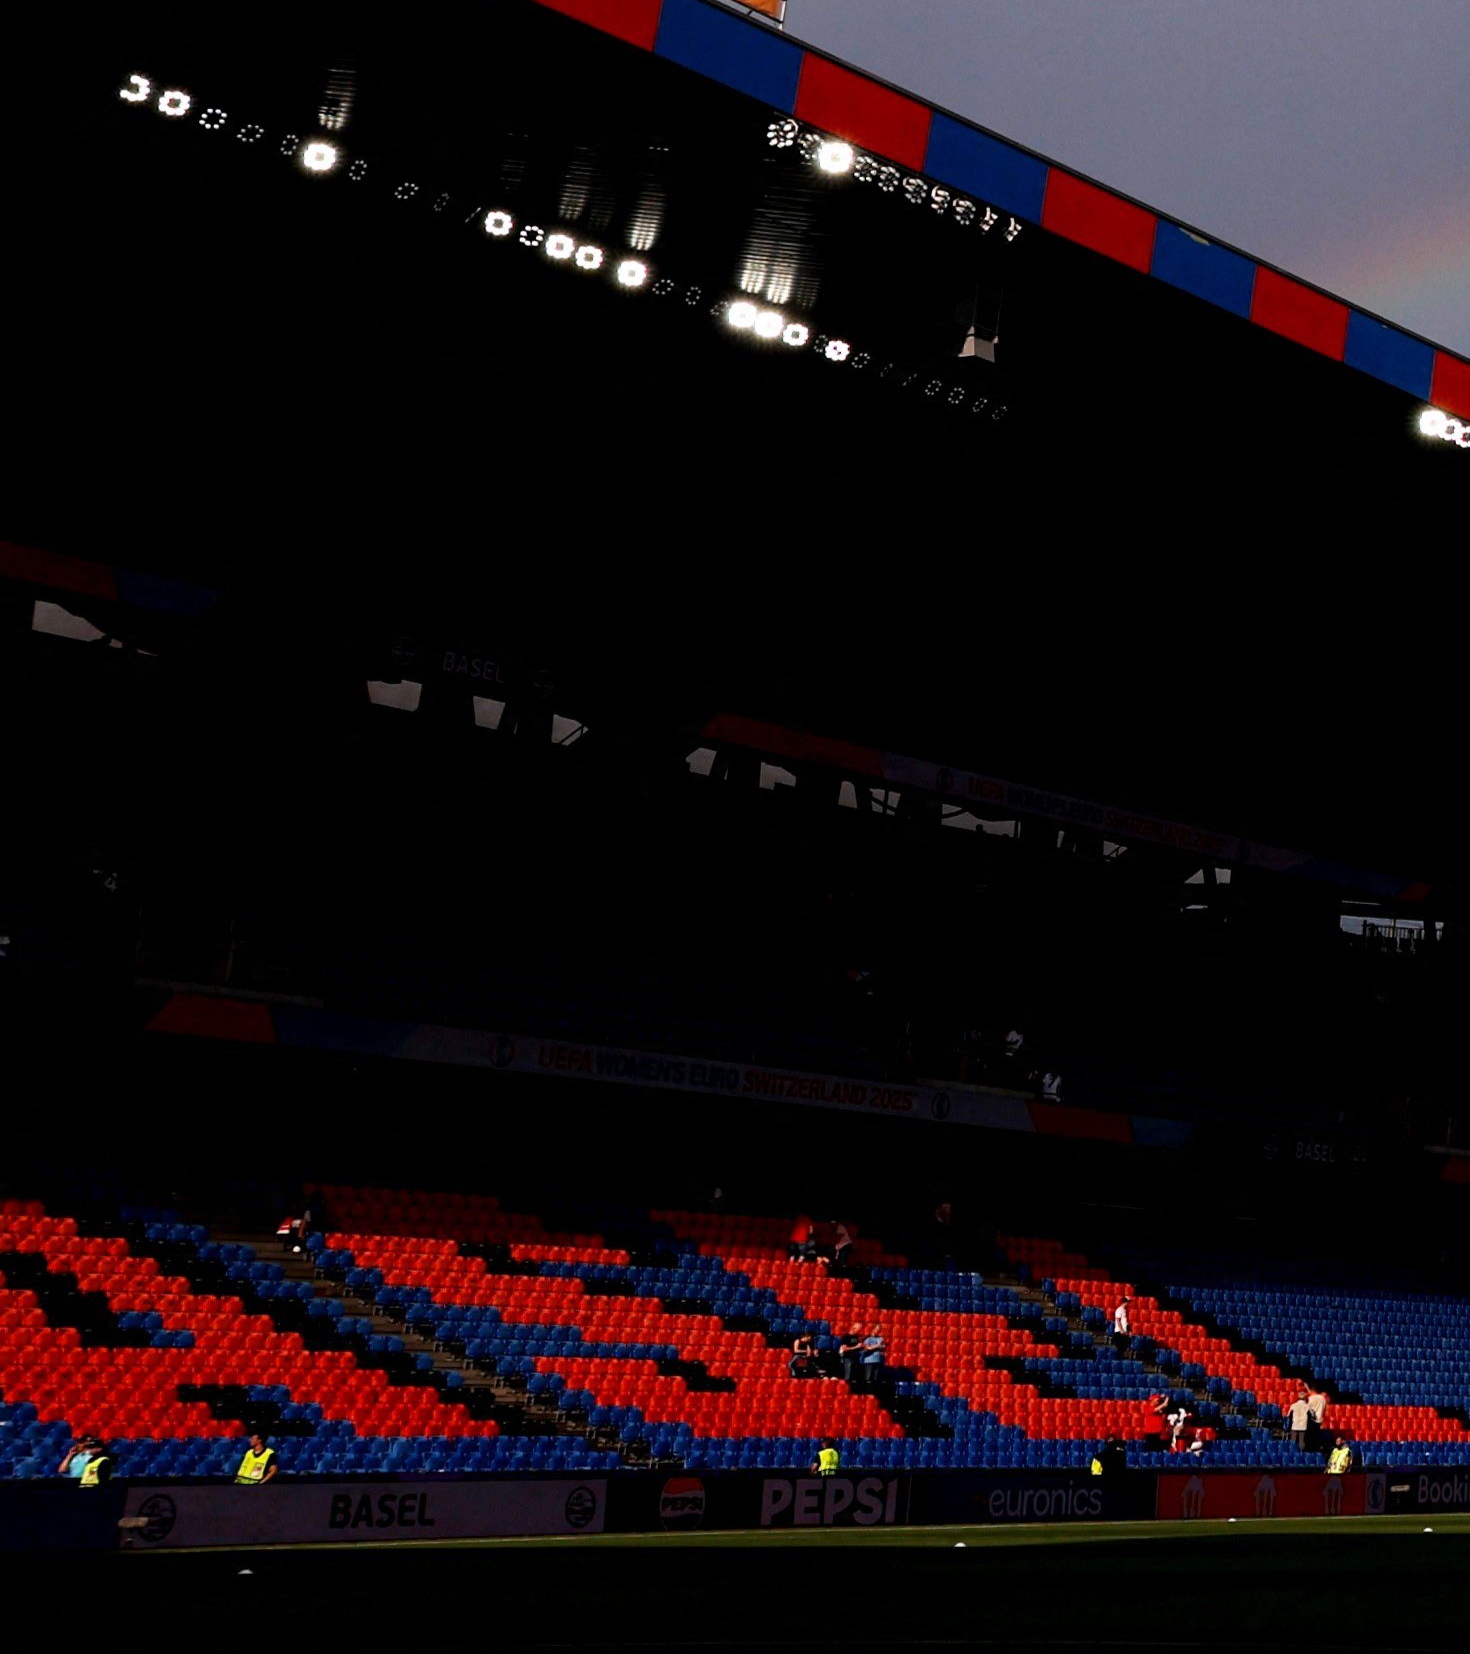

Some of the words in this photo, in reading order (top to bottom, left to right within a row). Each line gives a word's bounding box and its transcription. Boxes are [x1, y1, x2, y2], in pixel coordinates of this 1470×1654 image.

[442, 651, 505, 684] BASEL
[539, 1046, 592, 1073] UEFA
[743, 1070, 867, 1105] SWITZERLAND
[869, 1087, 913, 1111] 2025
[1295, 1140, 1335, 1162] BASEL
[329, 1493, 436, 1529] BASEL
[661, 1496, 704, 1514] PEPSI
[760, 1476, 899, 1526] PEPSI
[988, 1480, 1103, 1518] euronics
